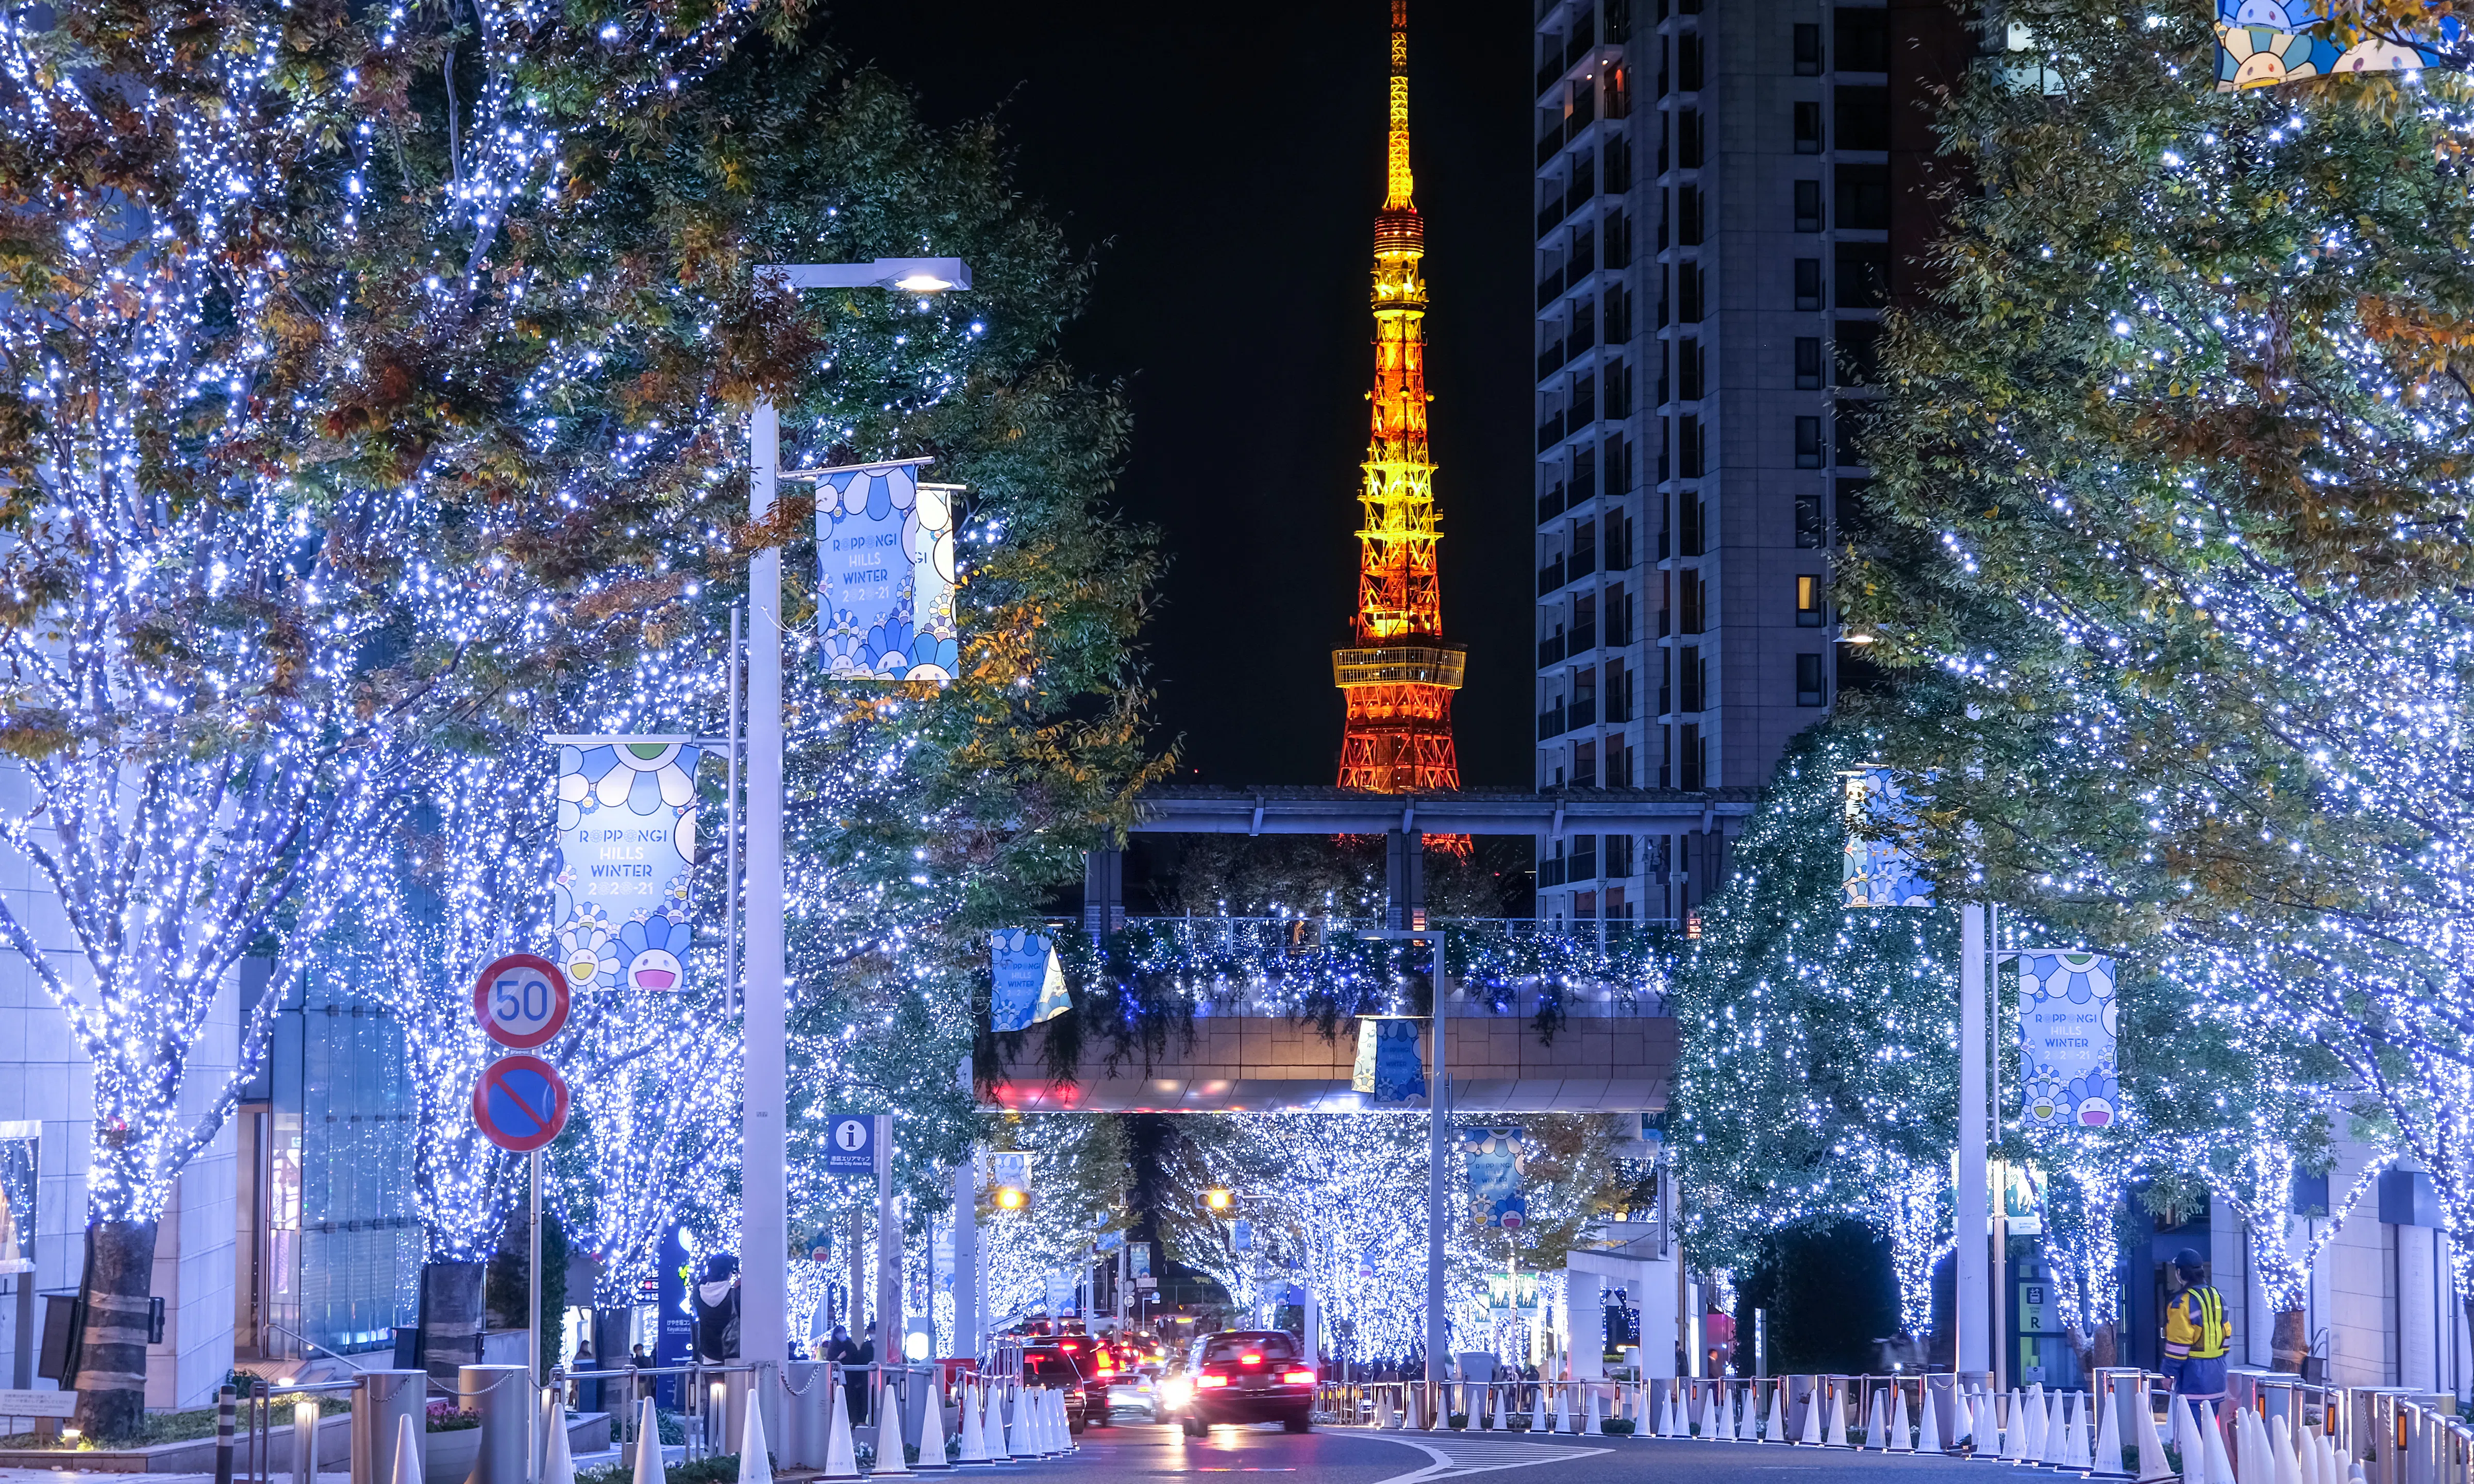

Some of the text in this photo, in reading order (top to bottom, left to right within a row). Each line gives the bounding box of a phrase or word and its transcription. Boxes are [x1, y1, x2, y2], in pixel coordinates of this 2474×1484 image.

[833, 533, 897, 551] ROPPONGI
[849, 552, 881, 567] HILLS
[843, 569, 888, 584] WINTER
[579, 829, 667, 844] ROPPONGI
[599, 847, 644, 861] HILLS
[590, 864, 653, 878] WINTER
[496, 981, 547, 1021] 50
[2035, 1014, 2097, 1023] ROPPONGI
[2050, 1026, 2082, 1035] HILLS
[2045, 1038, 2088, 1048] WINTER
[2031, 1317, 2041, 1328] R
